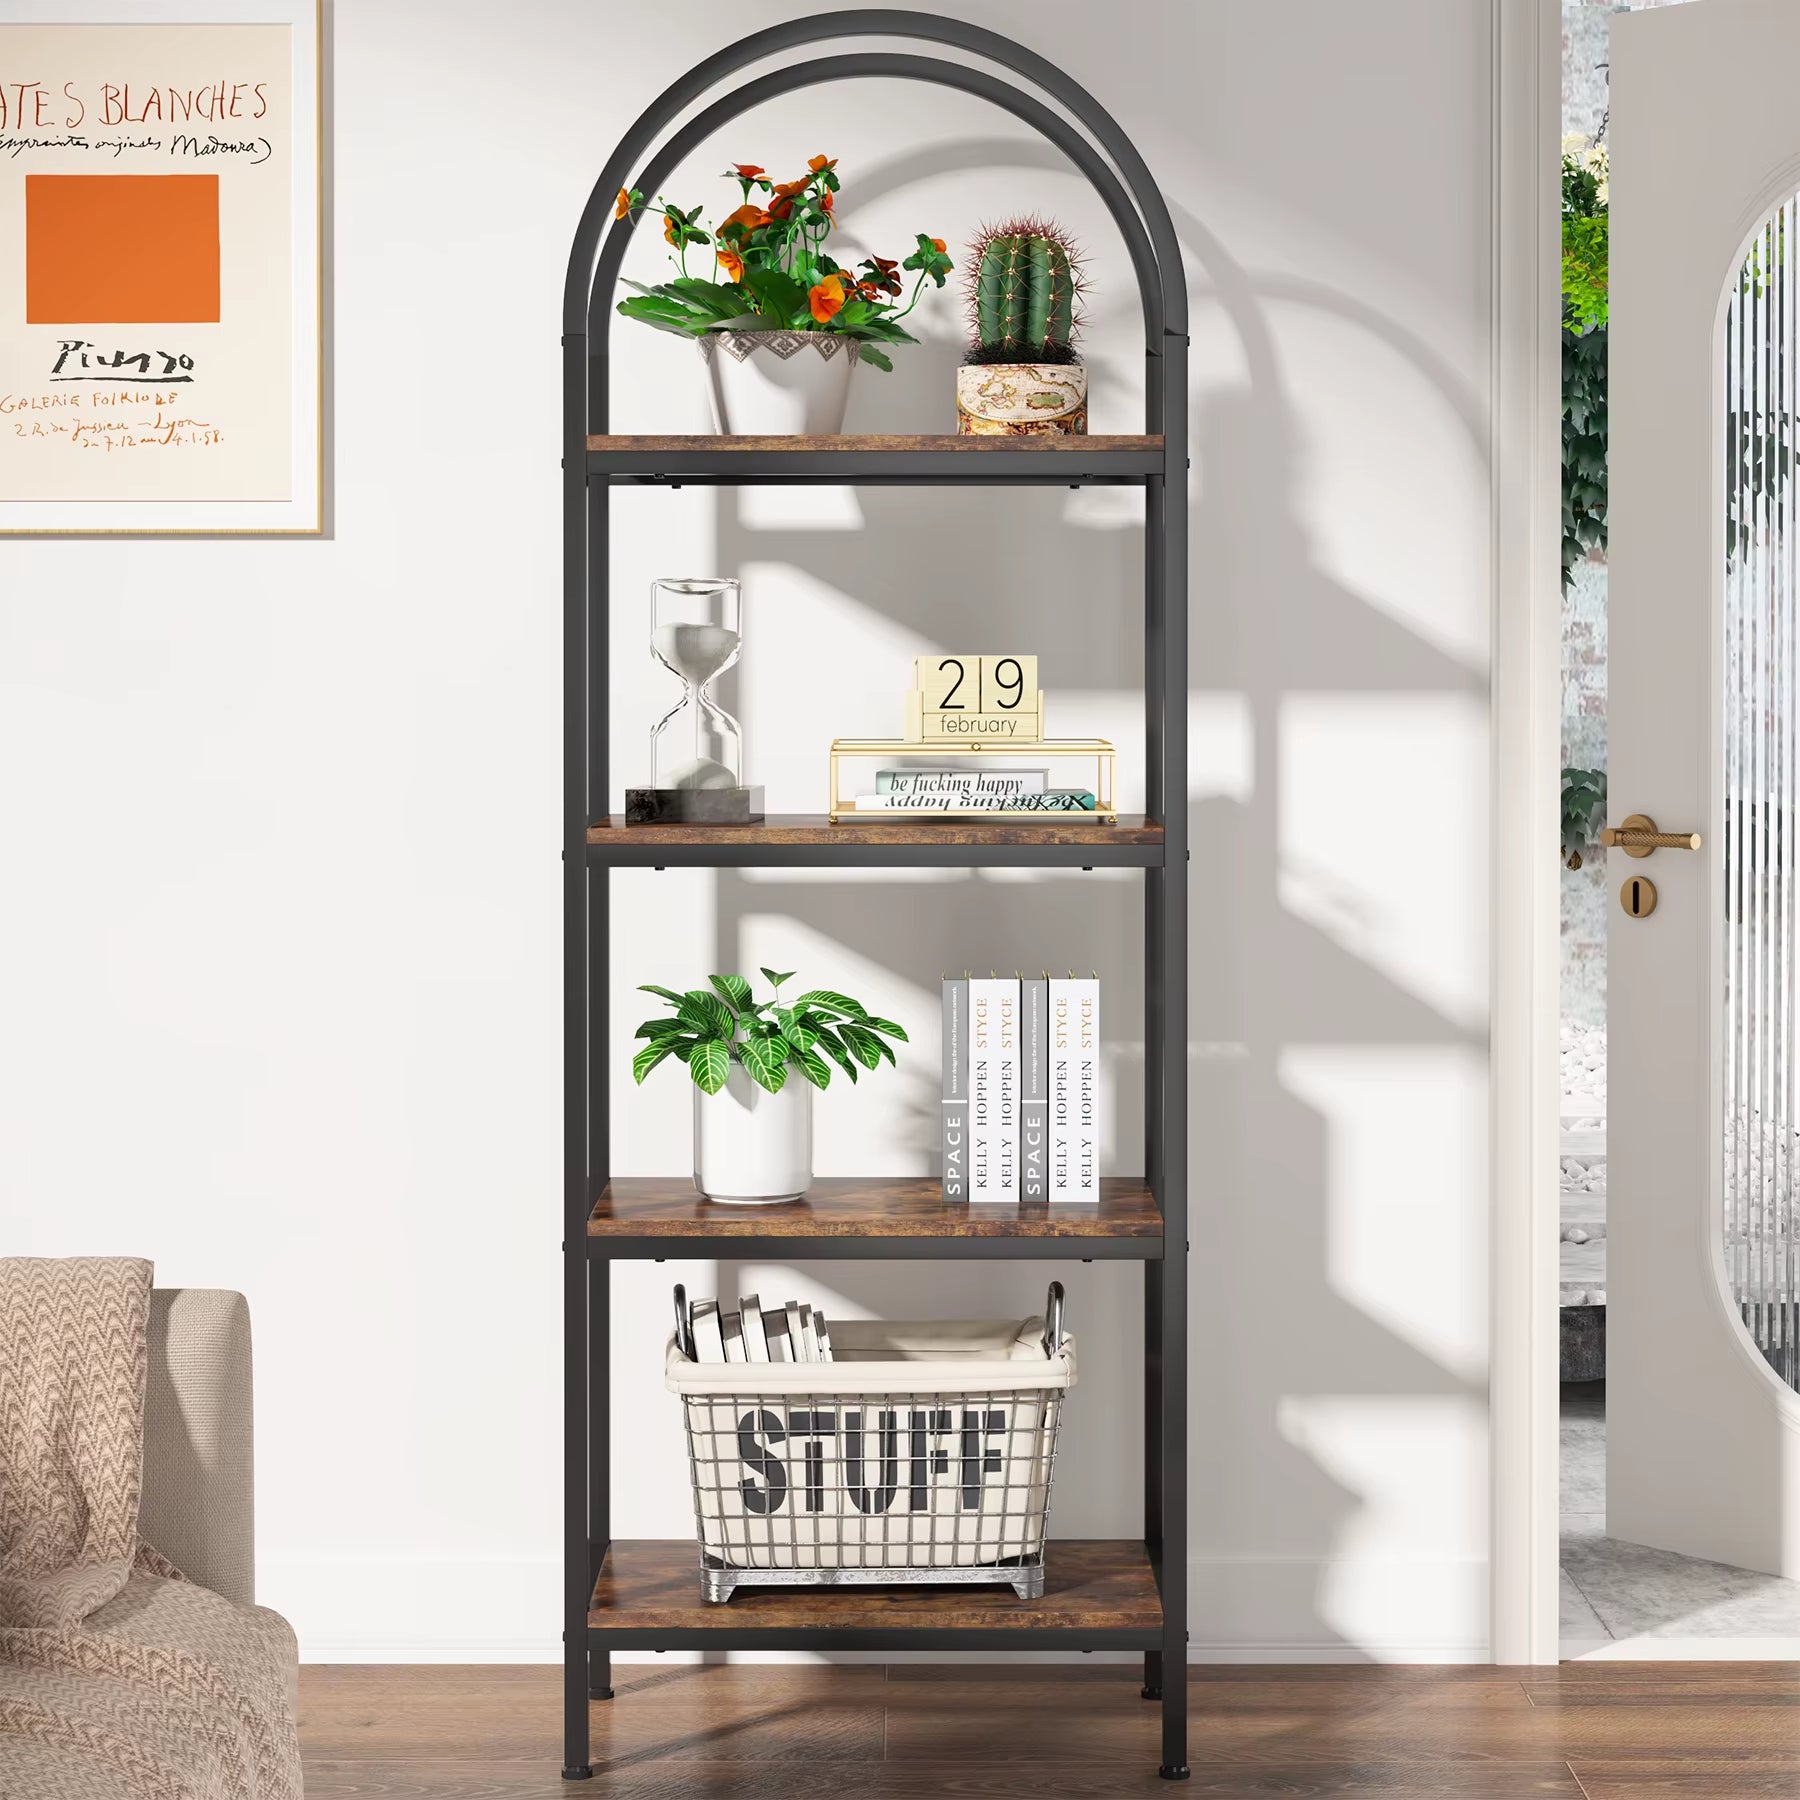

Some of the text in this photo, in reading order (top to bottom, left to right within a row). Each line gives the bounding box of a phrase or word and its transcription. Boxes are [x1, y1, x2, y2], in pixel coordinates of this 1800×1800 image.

[98, 80, 267, 126] BLANCHES
[940, 714, 1017, 737] february
[890, 772, 1023, 795] be fucking happy
[976, 998, 988, 1188] KELLY HOPPEN STYCE
[1001, 998, 1013, 1188] KELLY HOPPEN STYCE
[1056, 998, 1068, 1188] KELLY HOPPEN STYCE
[1081, 998, 1093, 1188] KELLY HOPPEN STYCE
[947, 1116, 961, 1195] SPACE
[1027, 1116, 1041, 1195] SPACE
[737, 1409, 1006, 1514] STUFF
